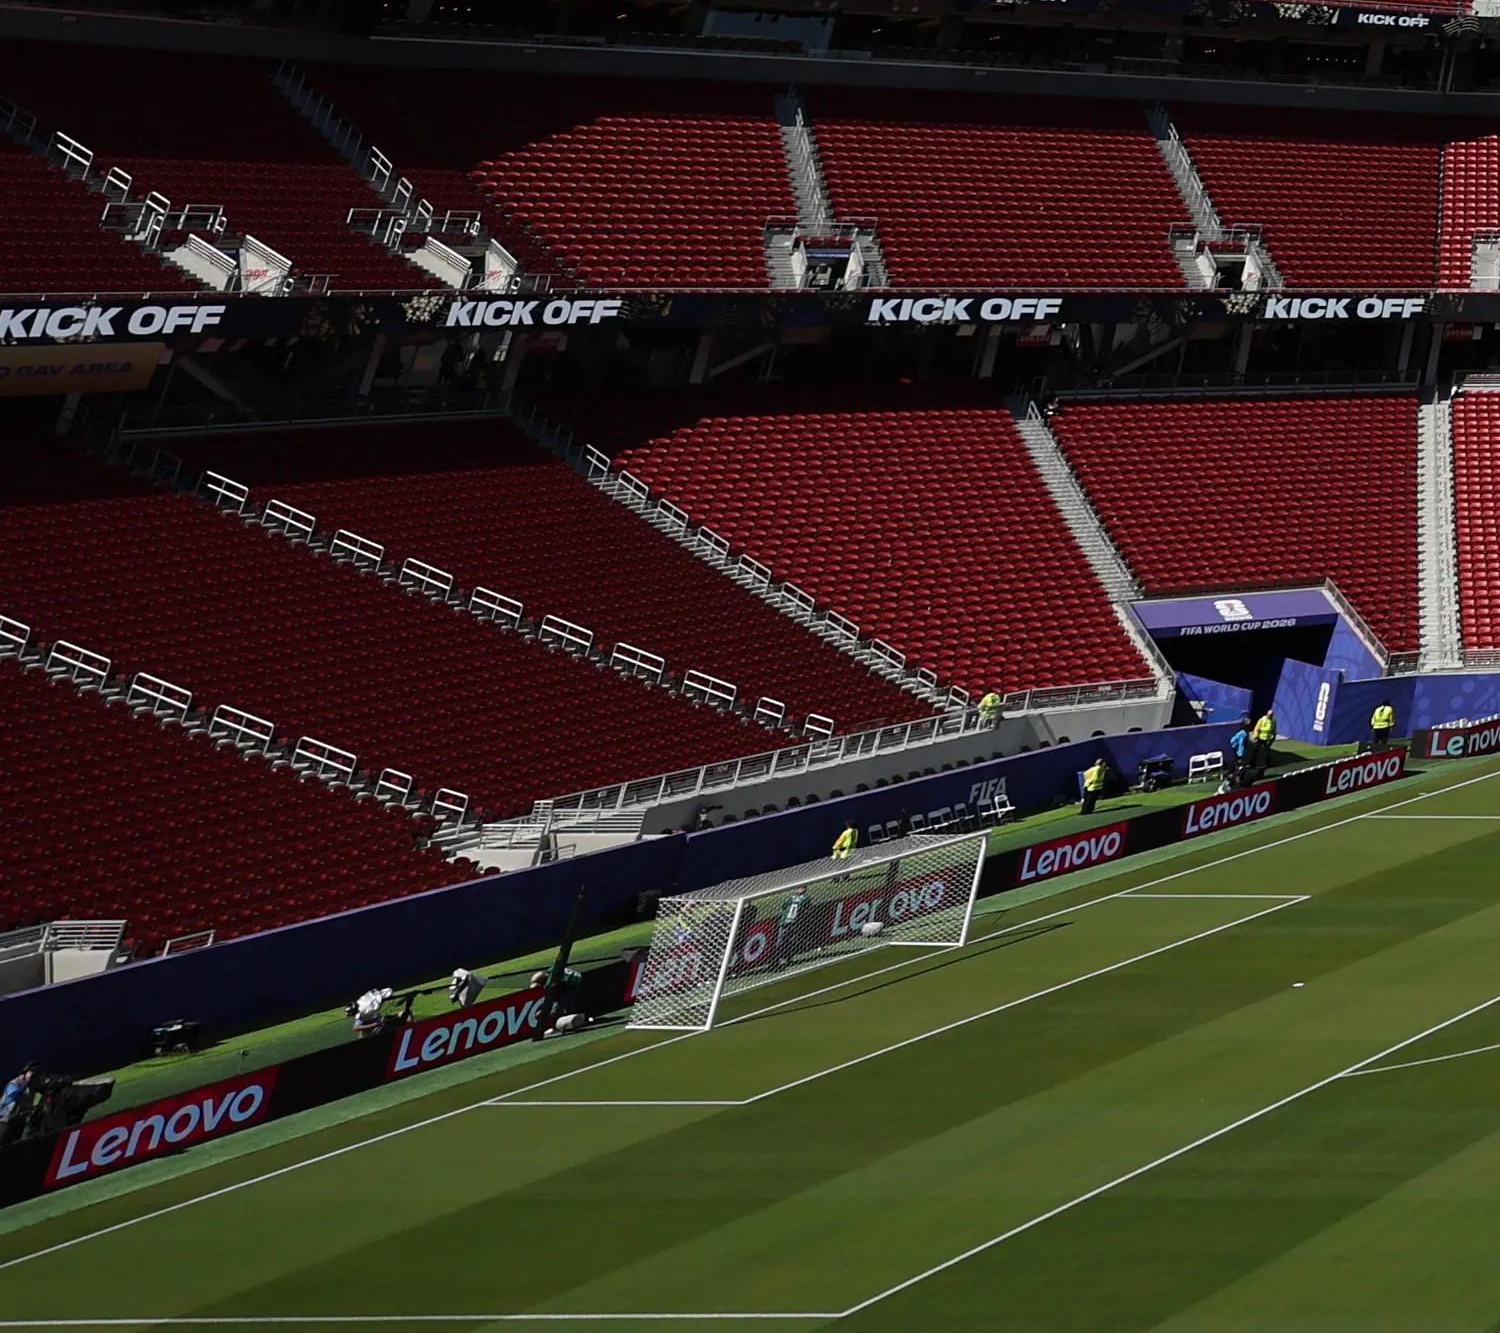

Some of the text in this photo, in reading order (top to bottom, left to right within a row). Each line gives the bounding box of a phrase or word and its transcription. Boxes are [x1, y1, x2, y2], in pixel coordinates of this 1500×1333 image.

[1358, 14, 1429, 27] KICK OFF
[446, 300, 622, 326] KICK OFF
[868, 298, 1062, 323] KICK OFF
[1265, 296, 1425, 318] KICK OFF
[0, 306, 226, 338] KICK OFF
[16, 364, 65, 376] BAY
[69, 363, 132, 374] AREA
[1181, 618, 1296, 636] FIFA WORLD CUP 2026
[1328, 755, 1401, 791] Lenovo
[969, 777, 1006, 803] FIFA
[1188, 788, 1270, 831] Lenovo
[1023, 829, 1122, 878] Lenovo
[55, 1086, 262, 1181] Lenovo
